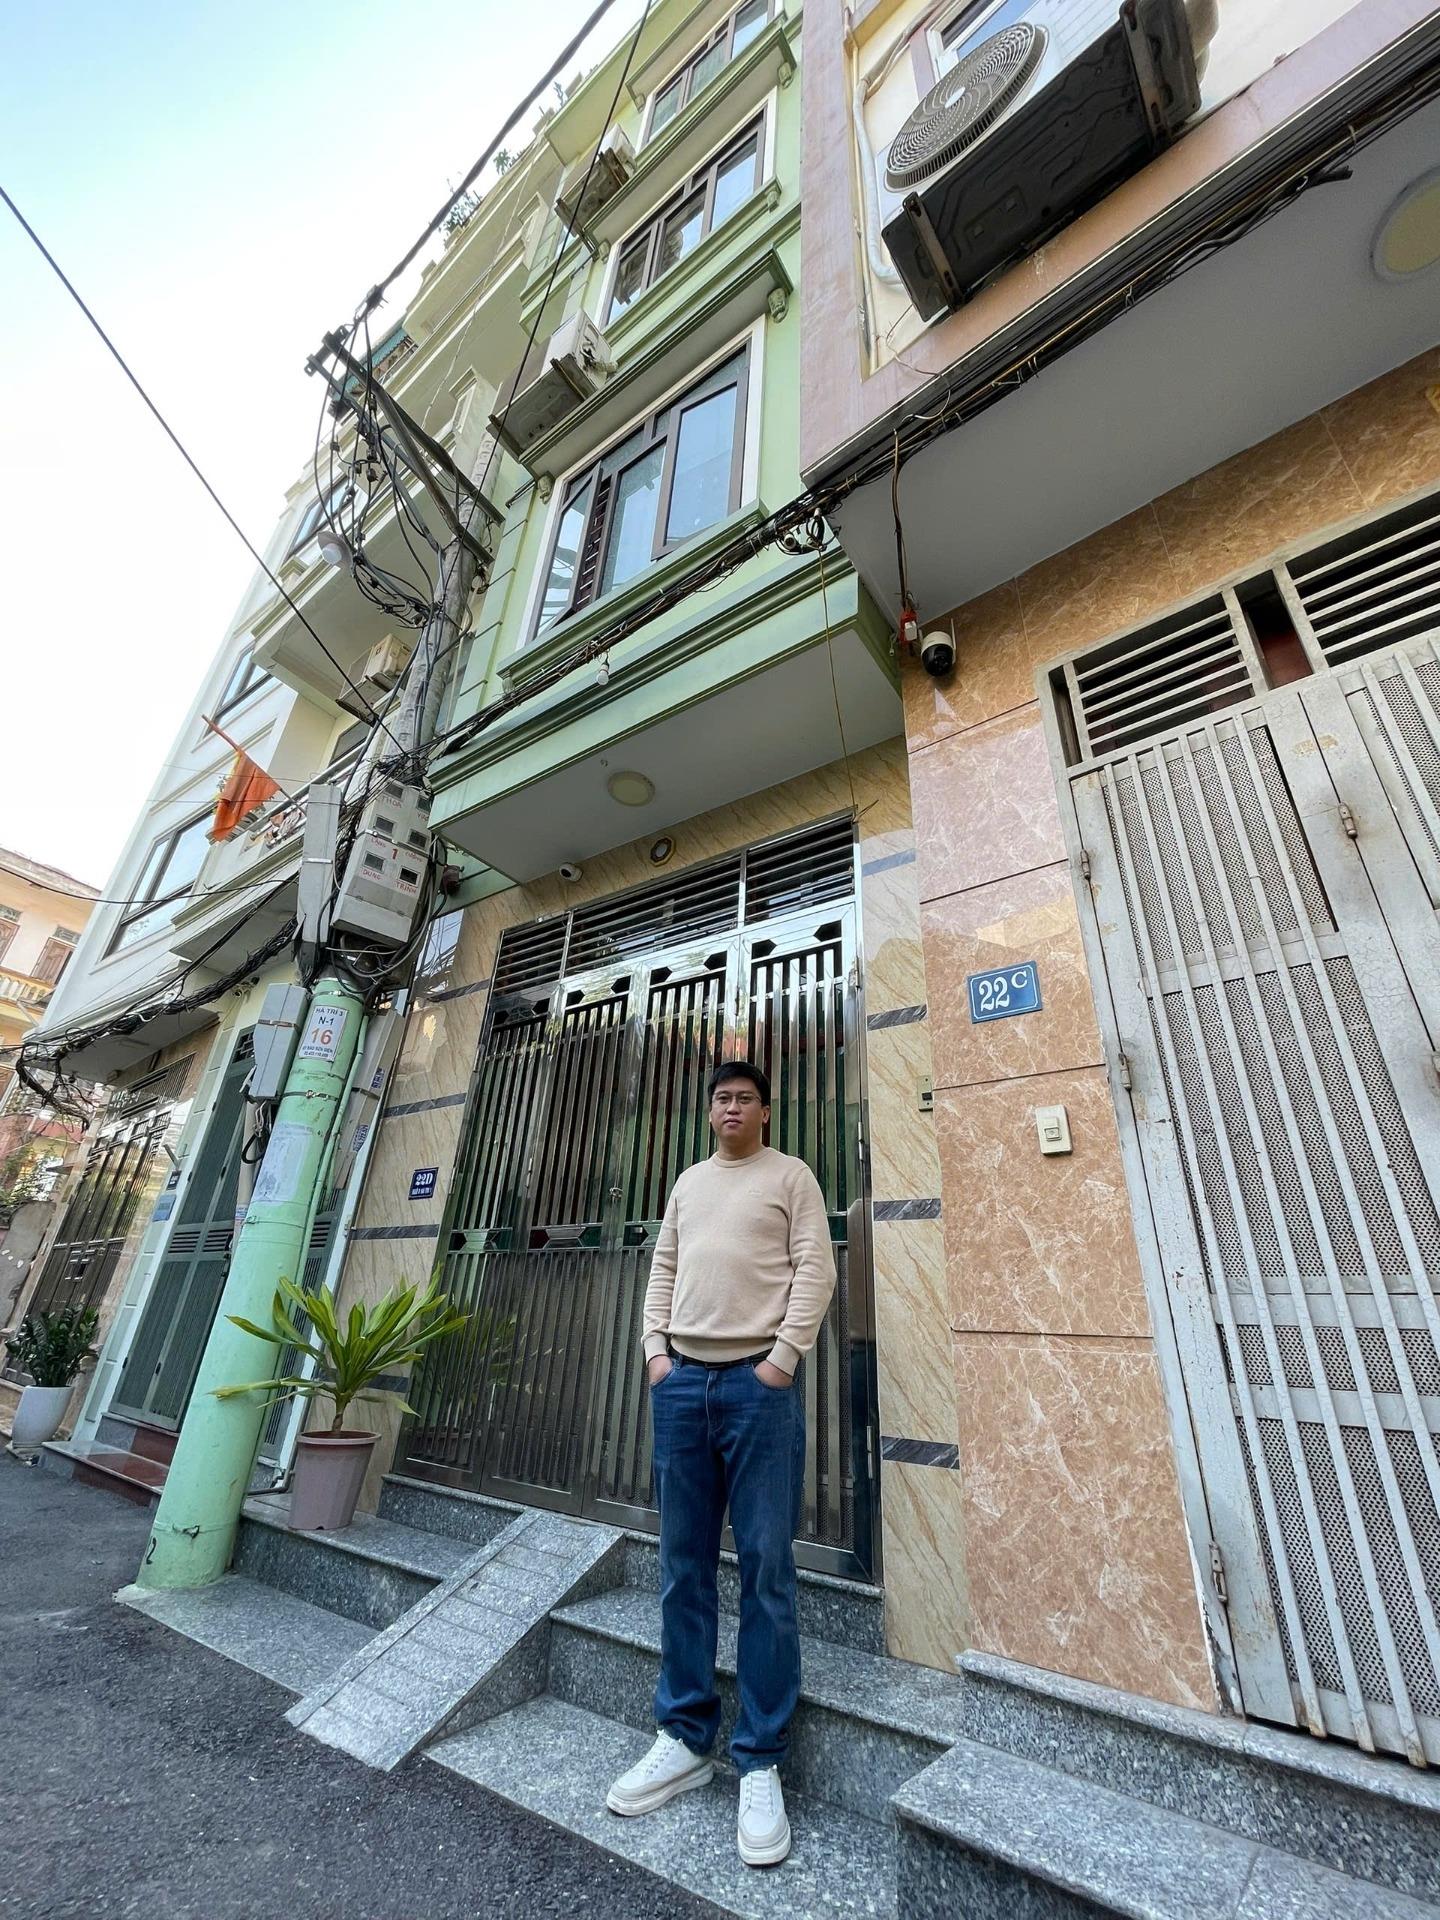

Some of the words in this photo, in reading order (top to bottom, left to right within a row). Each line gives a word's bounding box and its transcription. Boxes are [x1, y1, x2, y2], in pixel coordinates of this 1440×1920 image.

[392, 848, 398, 860] 1
[978, 970, 1028, 1012] 22C
[318, 1016, 335, 1026] N-1
[311, 1028, 333, 1045] 16
[415, 1172, 434, 1186] 22D
